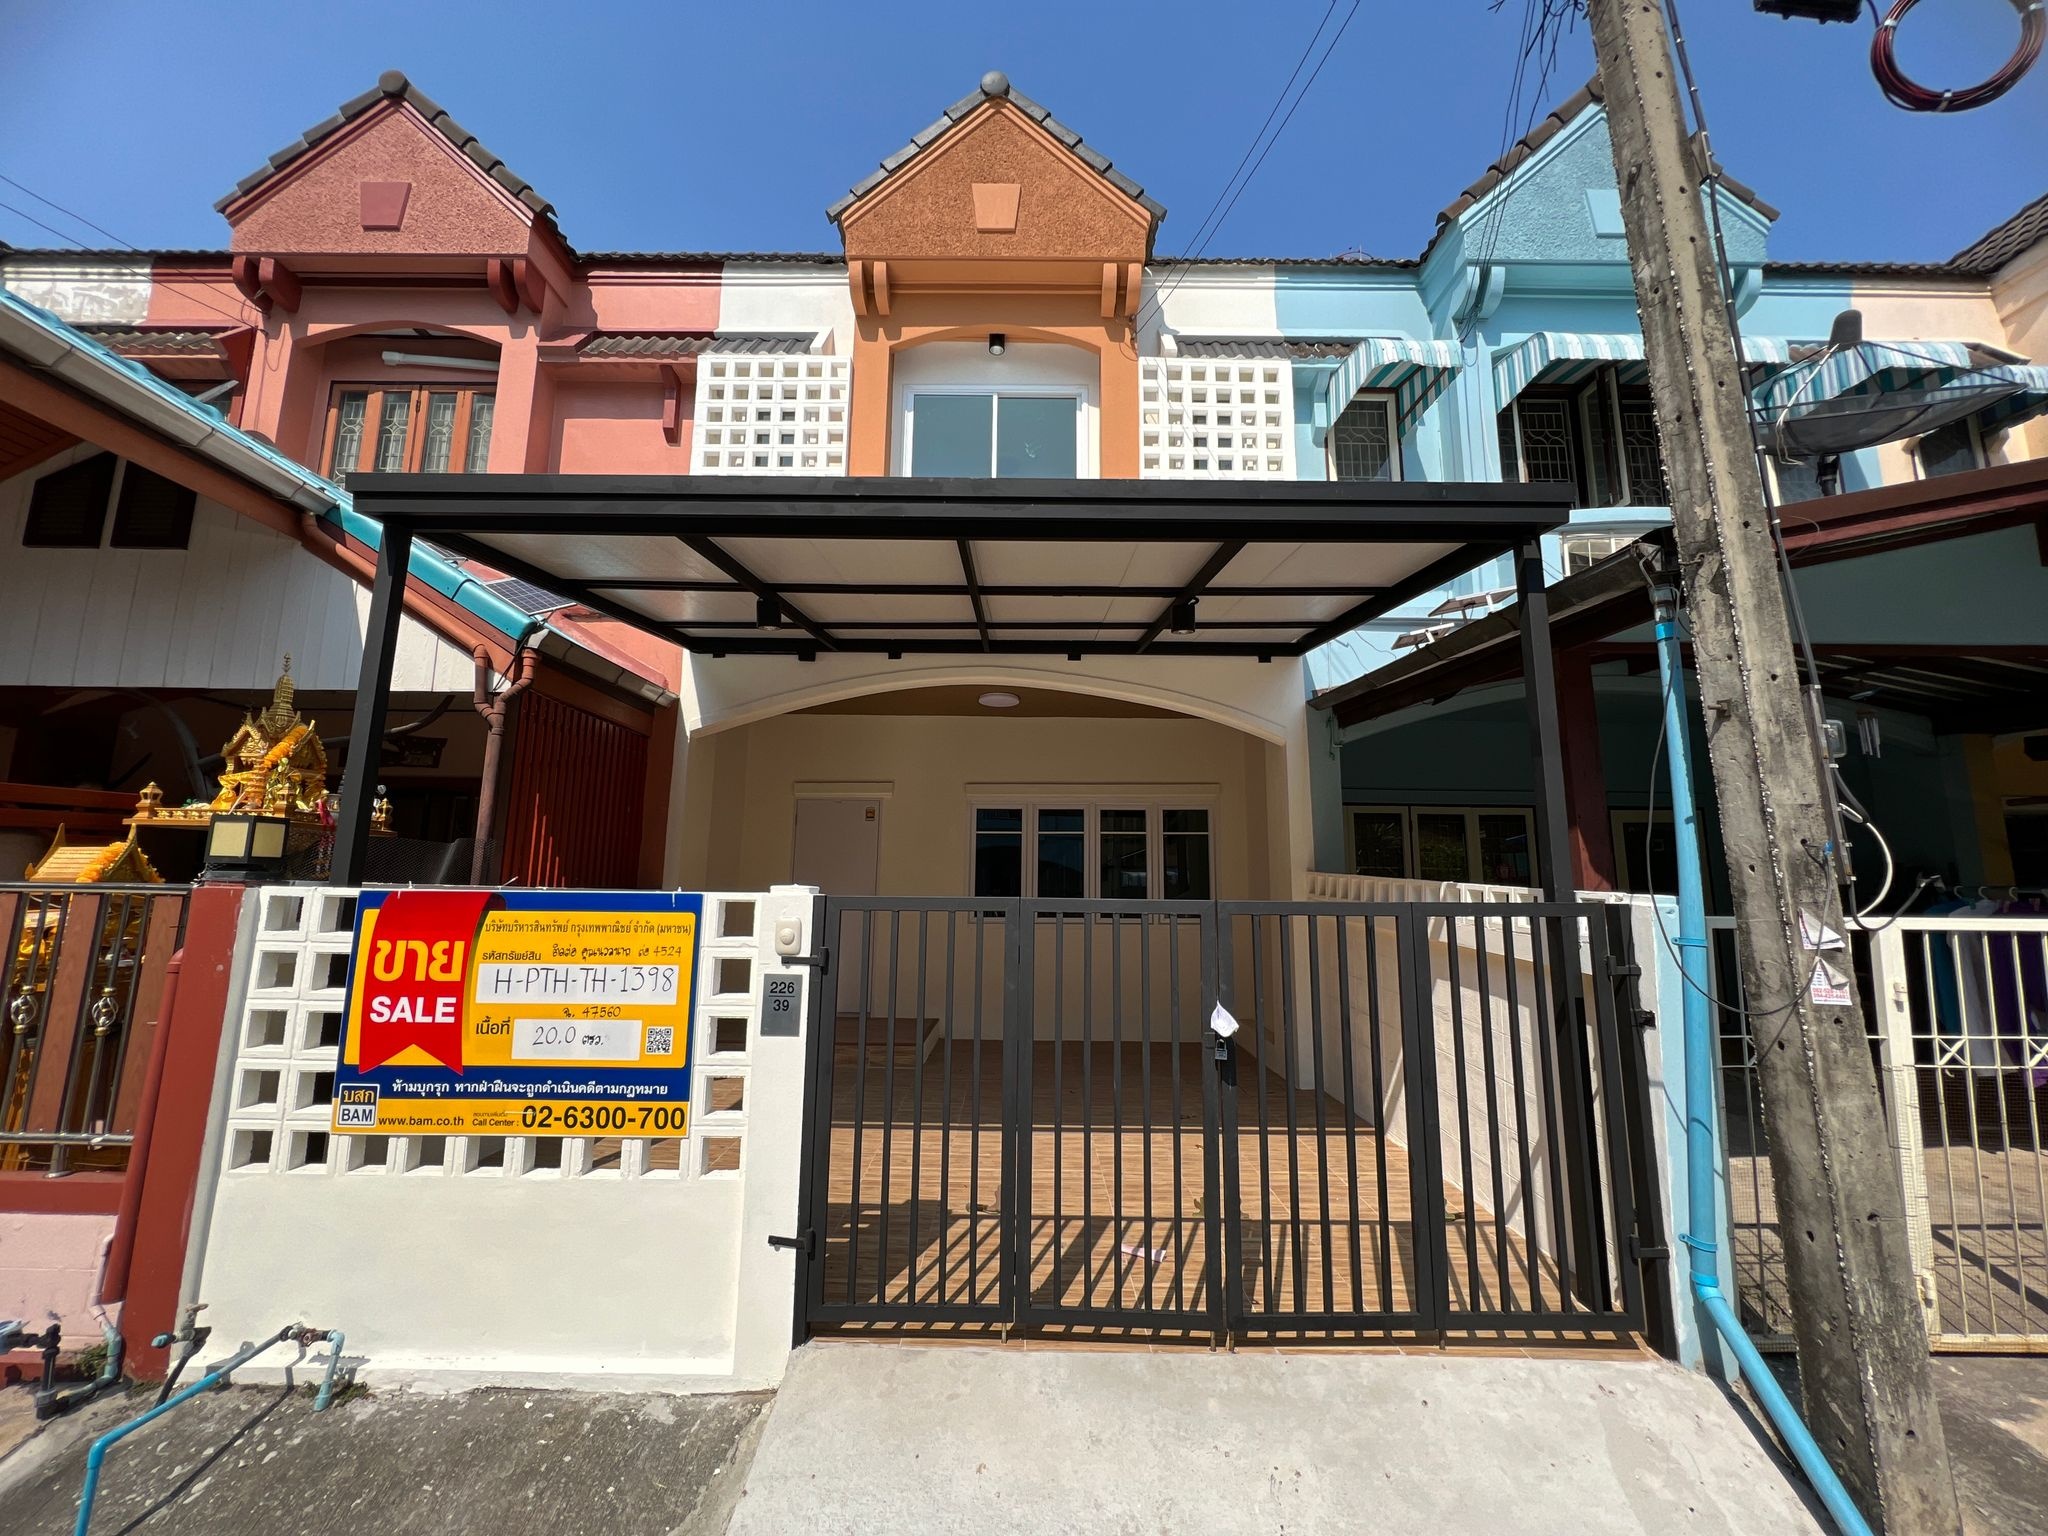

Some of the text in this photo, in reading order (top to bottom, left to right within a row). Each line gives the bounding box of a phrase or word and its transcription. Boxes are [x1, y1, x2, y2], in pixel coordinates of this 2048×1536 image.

[485, 919, 691, 937] บริษัทบริหารสินทรัพย์ กรุงเทพพาณิชย์ จำกัด (มหาชน)
[482, 948, 542, 961] รหัสทรัพย์สิน
[653, 946, 682, 957] 4524
[373, 939, 465, 982] ขาย
[494, 966, 675, 994] H-PTH-TH-1398
[770, 981, 795, 994] 226
[369, 996, 457, 1023] SALE
[582, 1006, 621, 1018] 47560
[773, 999, 789, 1012] 39
[475, 1015, 510, 1035] เนื้อที่
[532, 1026, 577, 1046] 20.0
[392, 1079, 668, 1098] ห้ามบุกรุก หากฝ่าฝืนจะถูกดำเนินคดีตามกฎหมาย
[343, 1089, 375, 1103] บสก
[341, 1108, 373, 1122] BAM
[379, 1116, 464, 1126] www.bam.co.th
[522, 1105, 685, 1130] 02-6300-700
[472, 1118, 487, 1126] Call
[489, 1118, 514, 1127] Center
